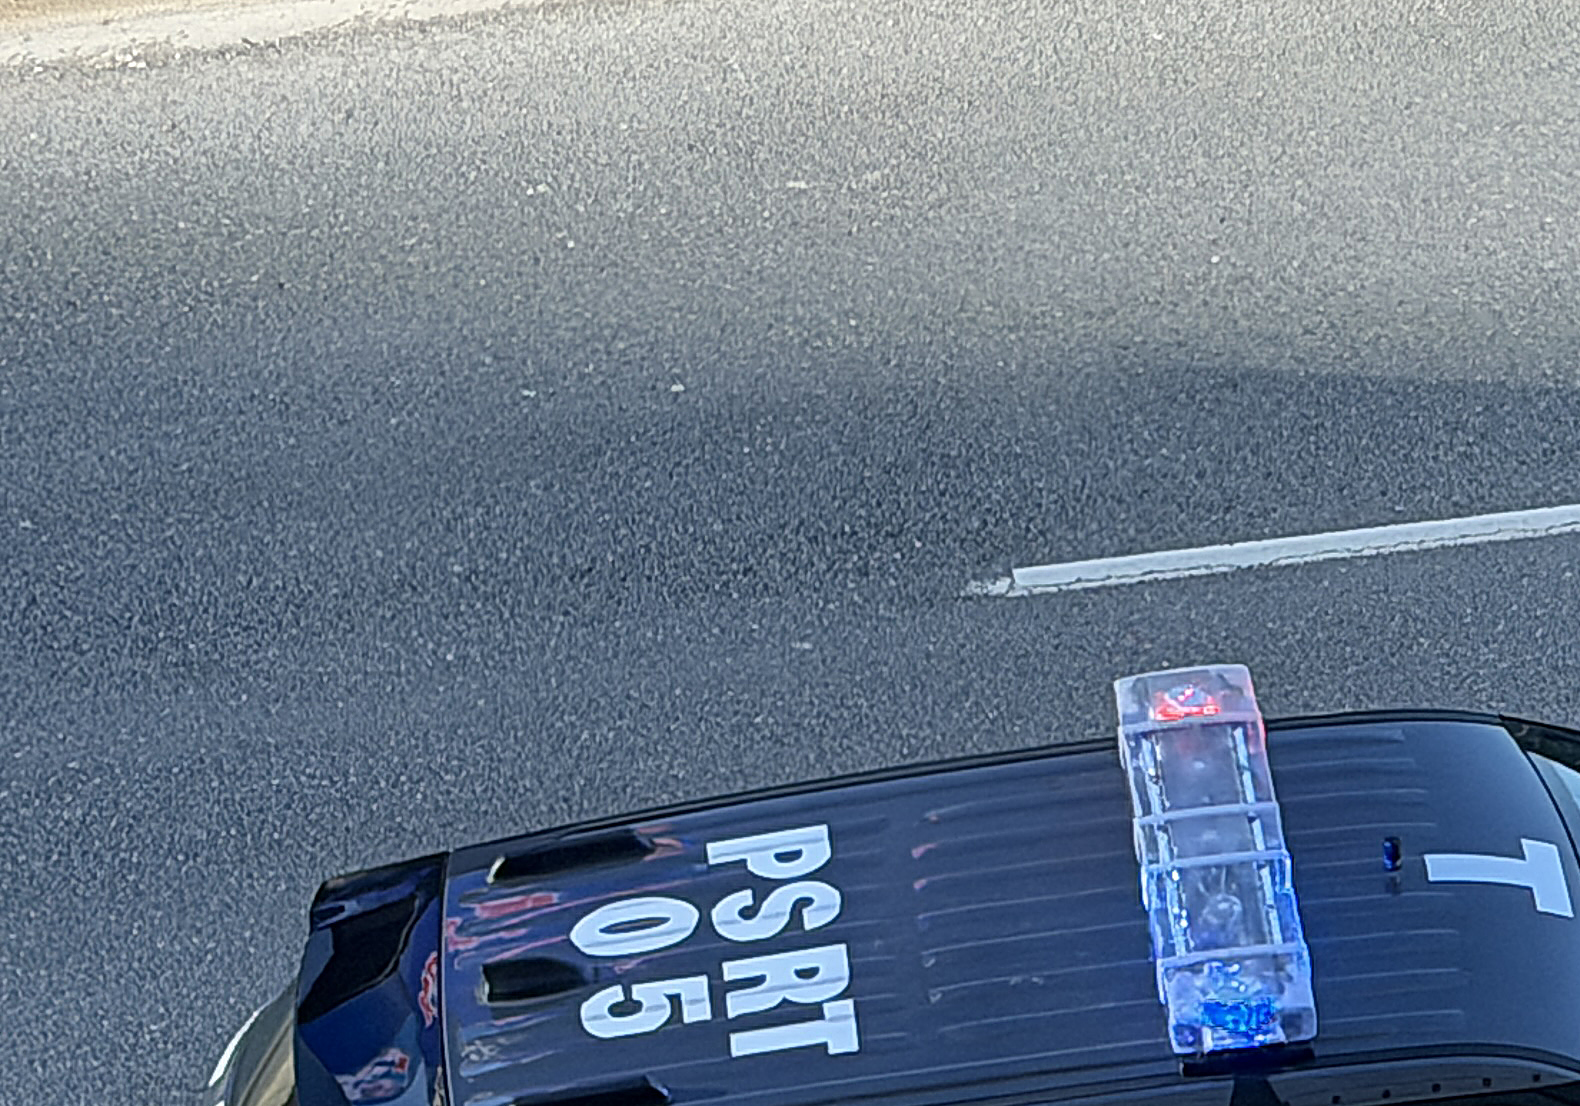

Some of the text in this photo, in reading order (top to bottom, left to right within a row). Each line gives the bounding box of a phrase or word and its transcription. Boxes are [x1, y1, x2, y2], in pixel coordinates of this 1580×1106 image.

[706, 824, 859, 1058] PSRT
[1423, 838, 1574, 918] T
[569, 896, 712, 1039] 05
